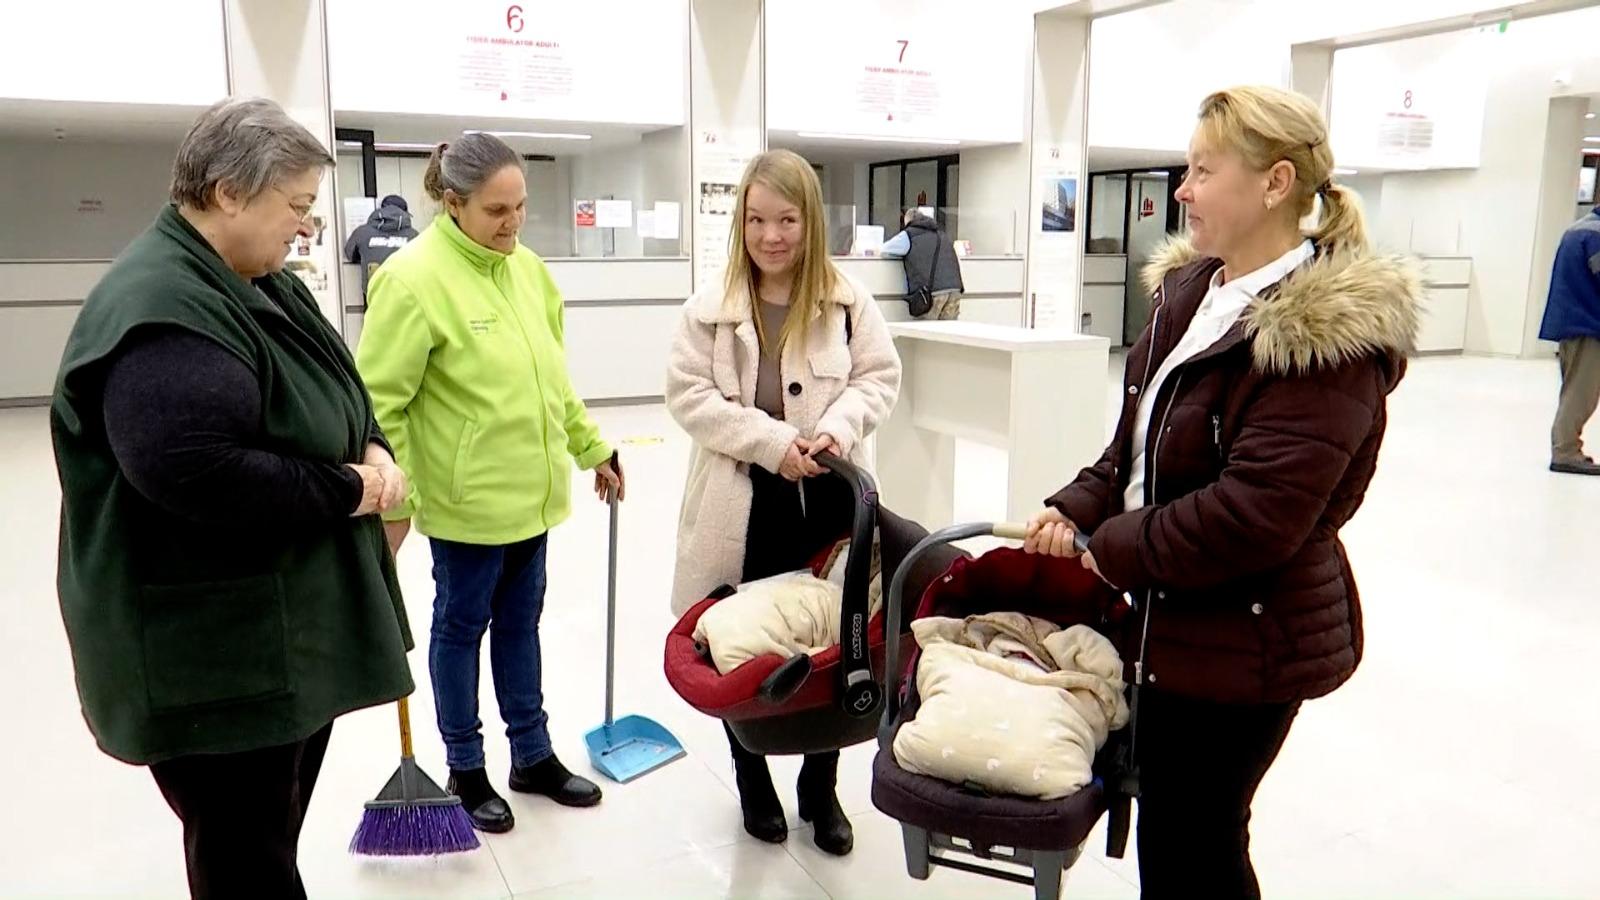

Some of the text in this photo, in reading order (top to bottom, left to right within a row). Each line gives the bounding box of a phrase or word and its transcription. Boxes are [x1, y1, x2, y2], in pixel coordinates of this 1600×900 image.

[506, 4, 525, 33] 6
[896, 39, 909, 63] 7
[1403, 89, 1413, 109] 8
